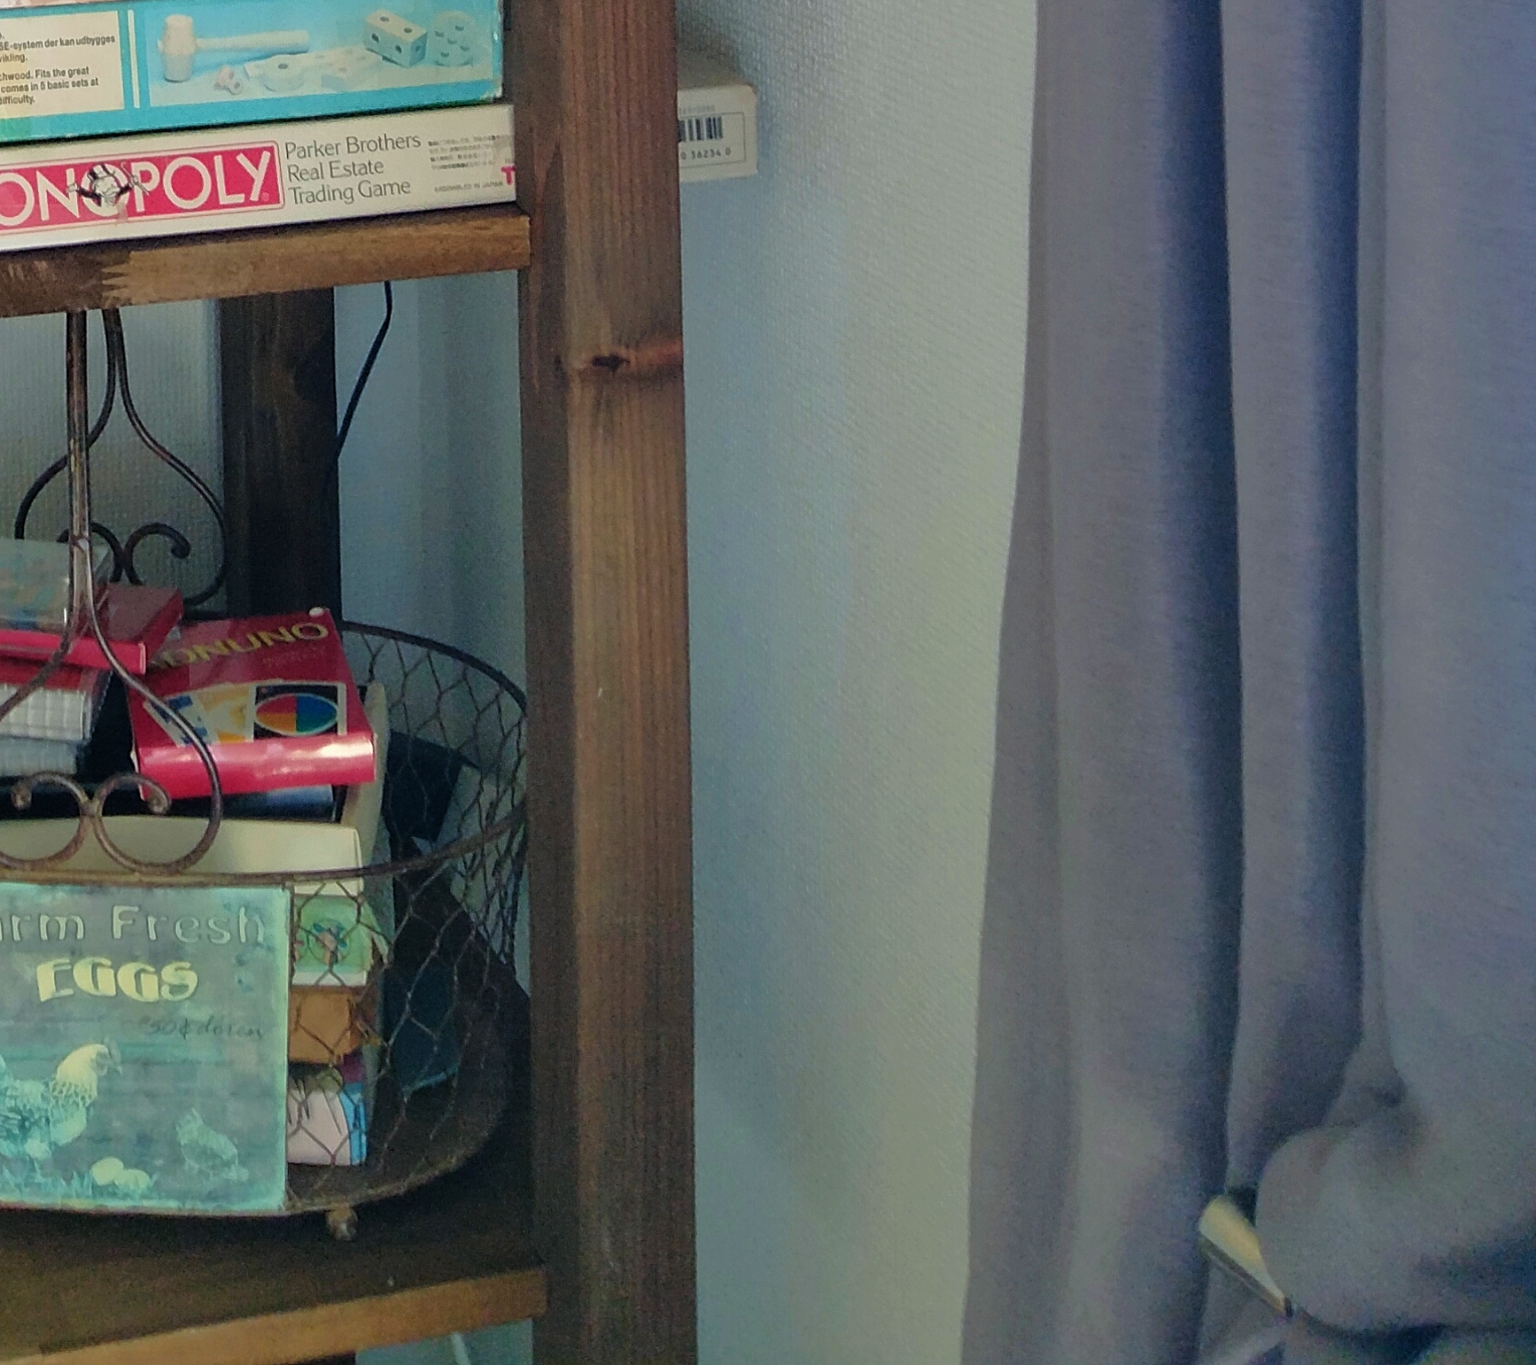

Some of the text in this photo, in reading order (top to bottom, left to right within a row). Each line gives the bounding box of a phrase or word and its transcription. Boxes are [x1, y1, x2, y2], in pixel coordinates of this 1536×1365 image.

[0, 82, 29, 94] comes
[30, 81, 39, 92] in
[47, 78, 70, 90] basic
[70, 77, 89, 88] sets
[89, 76, 99, 87] at
[51, 67, 66, 78] the
[67, 66, 90, 78] great
[284, 138, 341, 161] Parker
[345, 132, 422, 155] Brothers
[287, 158, 385, 181] Real Estate
[288, 178, 412, 206] Trading Game
[110, 904, 266, 947] Fresh
[34, 954, 199, 1004] EGGS
